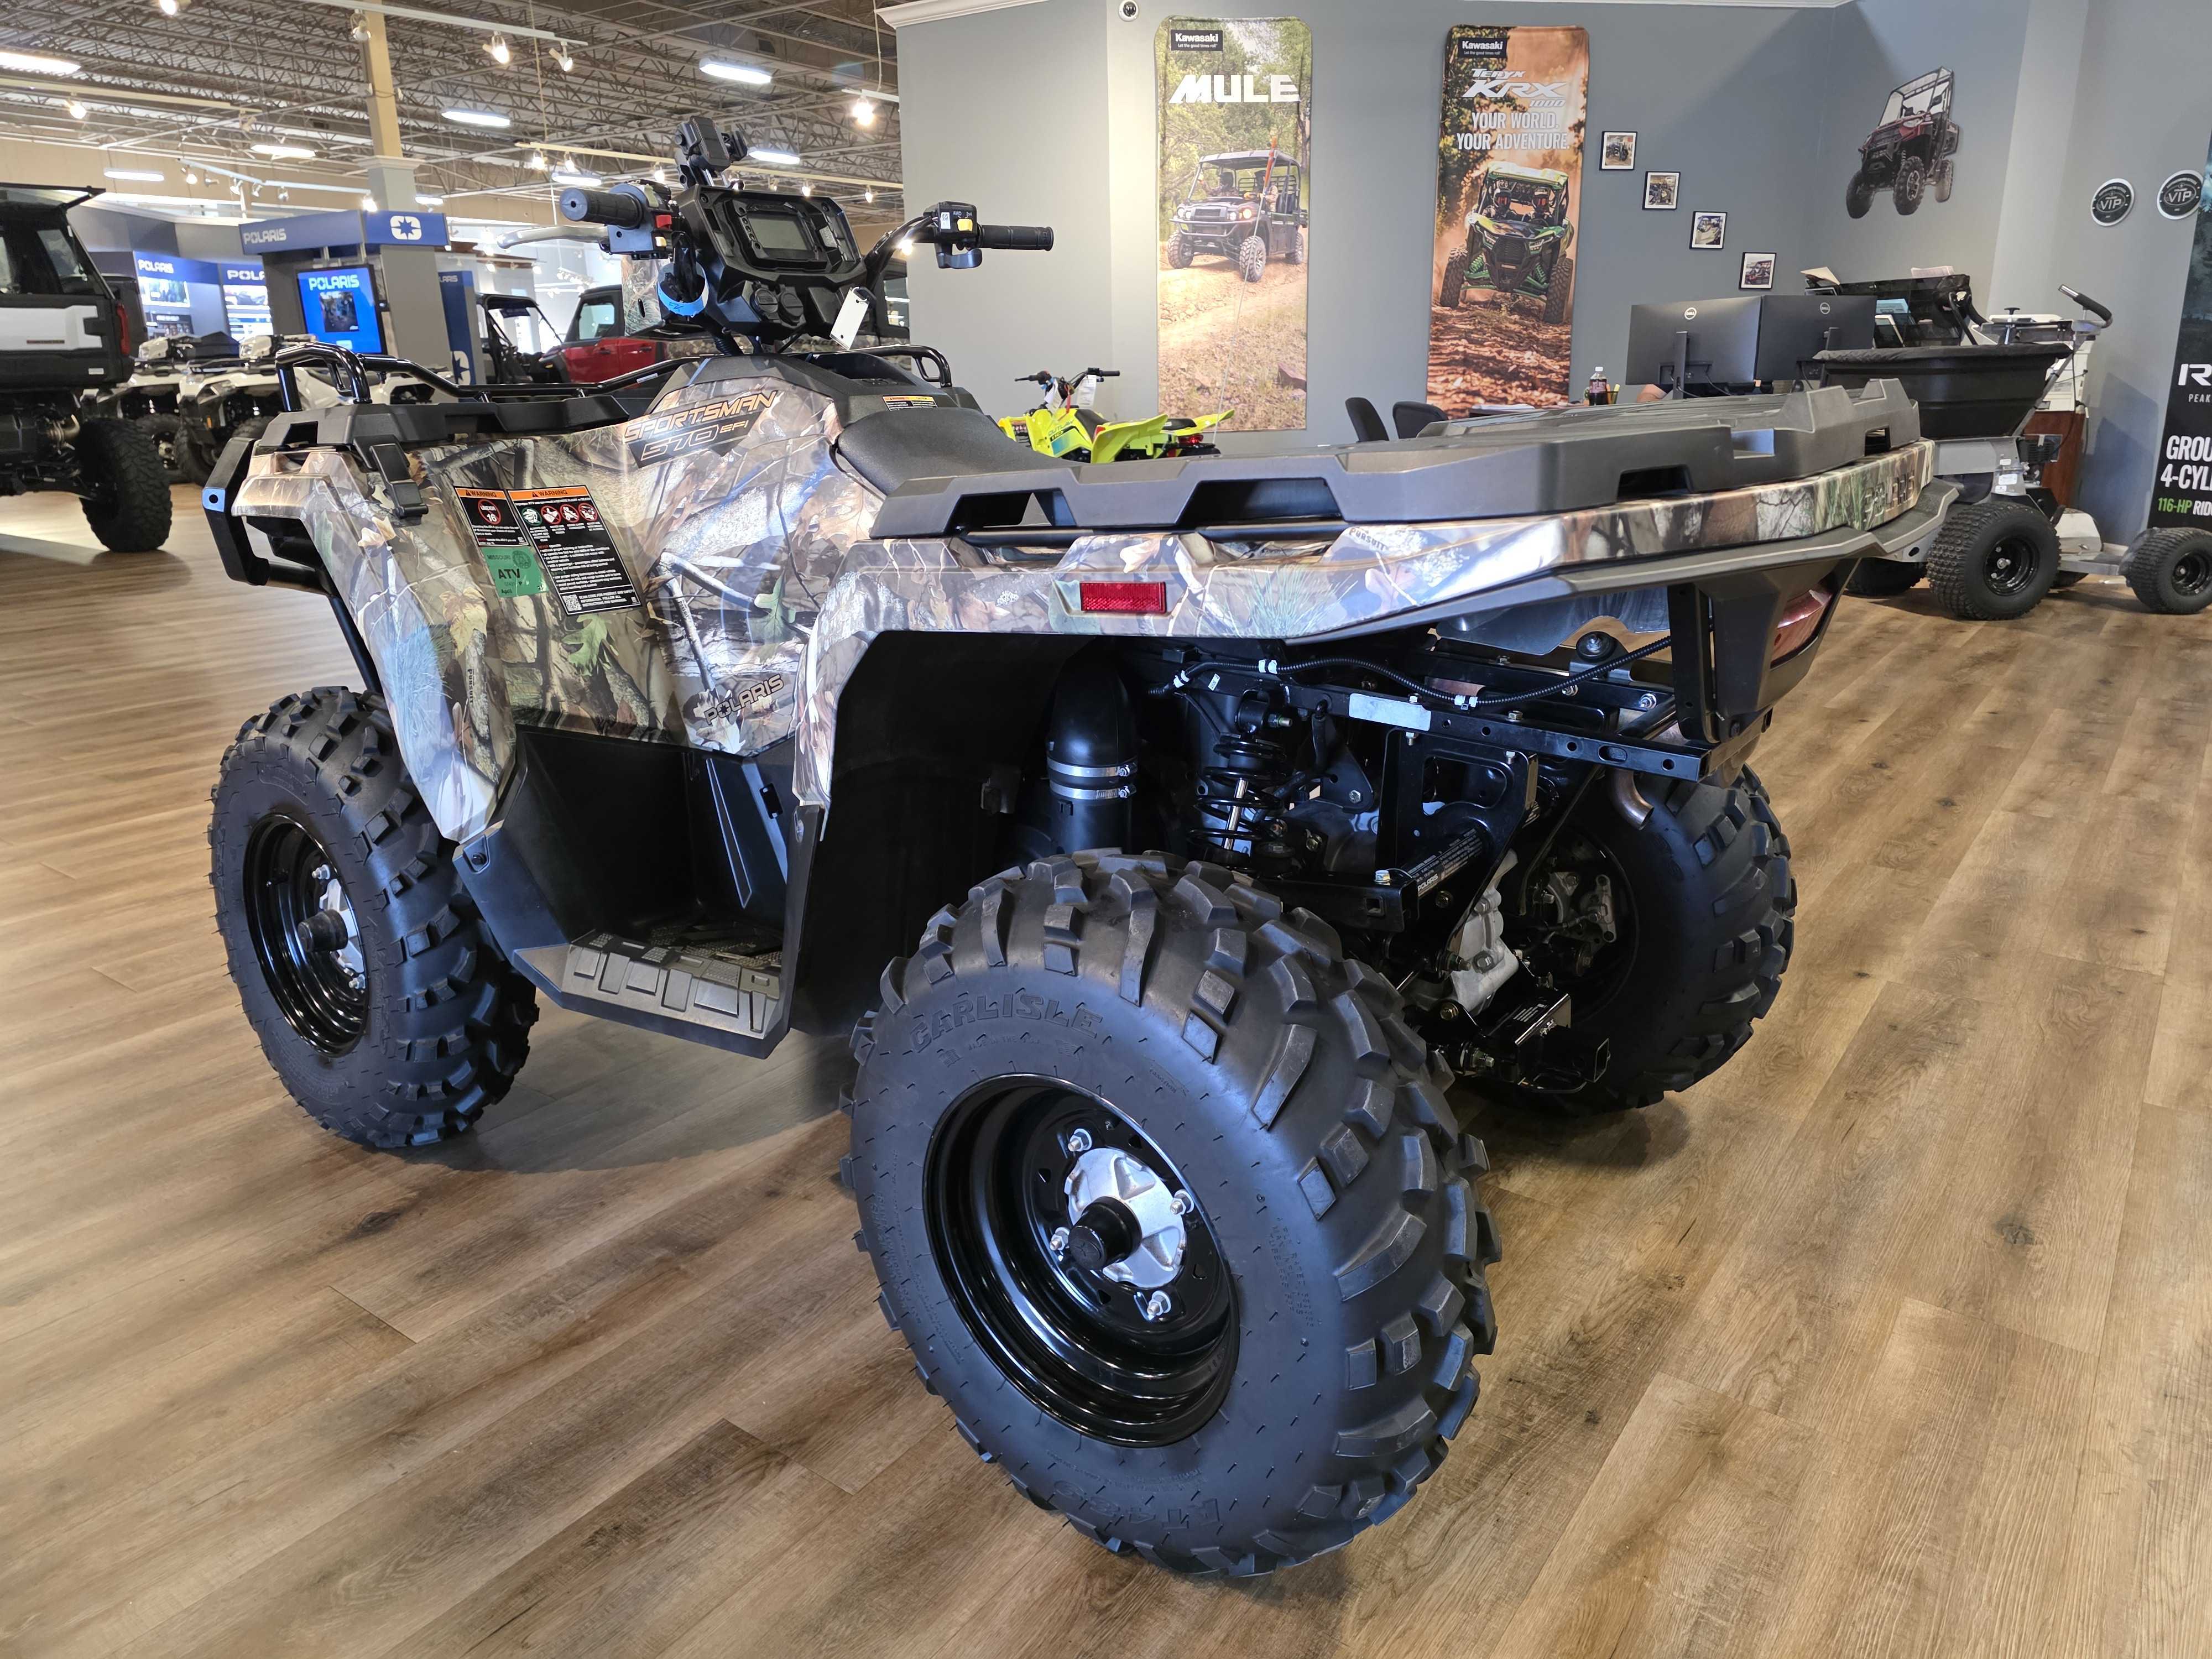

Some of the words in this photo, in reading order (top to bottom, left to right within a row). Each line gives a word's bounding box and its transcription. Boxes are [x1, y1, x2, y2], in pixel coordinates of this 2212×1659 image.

[1175, 33, 1218, 42] Kawasaki
[1462, 40, 1503, 50] Kawasaki
[1168, 74, 1301, 104] MULE
[1462, 79, 1569, 98] KRX
[1530, 99, 1567, 107] 1000
[1472, 112, 1506, 129] YOUR
[1511, 112, 1559, 129] WORLD.
[1457, 133, 1491, 150] YOUR
[1495, 133, 1571, 150] ADVENTURE.
[2100, 199, 2122, 210] VIP
[2168, 191, 2192, 203] VIP
[243, 228, 287, 244] POLARIS
[138, 259, 174, 274] POLARIS
[309, 274, 359, 290] POLARIS
[2189, 393, 2211, 403] PEAK
[623, 390, 778, 443] SPORTSMAN
[640, 424, 719, 461] 570
[719, 420, 749, 434] EFI
[2158, 497, 2193, 514] 116-HP
[487, 514, 497, 522] 16
[498, 568, 520, 579] ATV
[703, 674, 784, 725] POLARIS
[1417, 873, 1438, 892] POLARIS
[910, 993, 1103, 1053] CARLISLE
